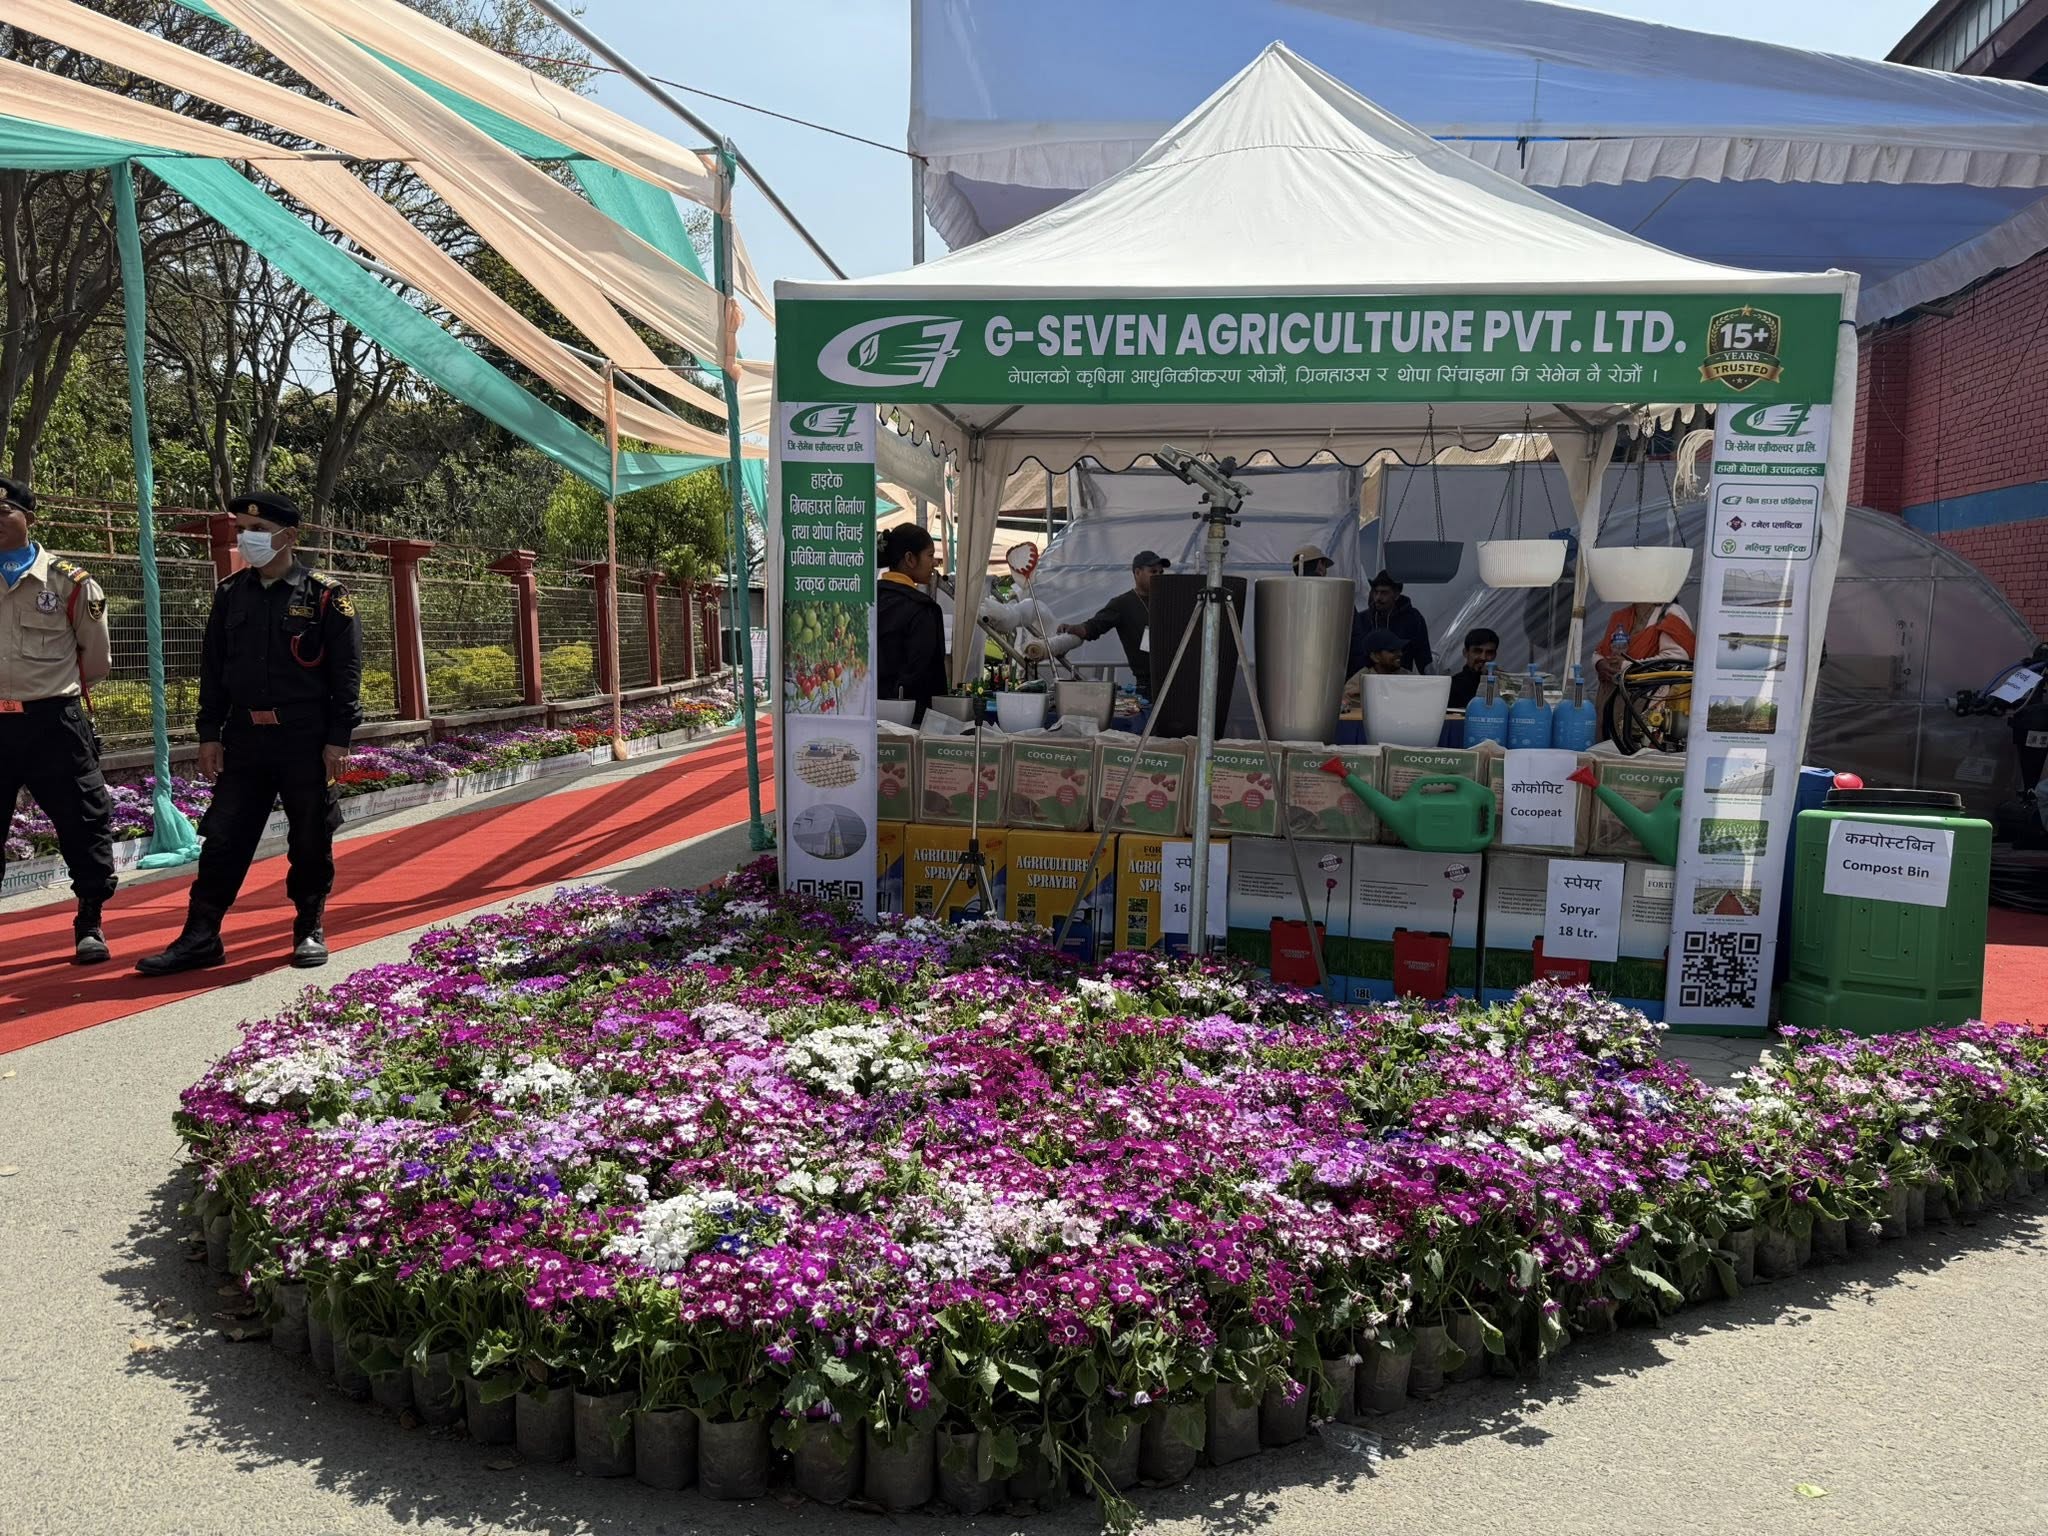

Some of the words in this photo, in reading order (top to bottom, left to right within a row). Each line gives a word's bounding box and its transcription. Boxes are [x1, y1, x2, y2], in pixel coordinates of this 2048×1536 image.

[985, 314, 1167, 356] G-SEVEN
[1175, 310, 1474, 355] AGRICULTURE
[1483, 310, 1582, 353] PVT.
[1592, 310, 1687, 354] LTD.
[1720, 323, 1769, 349] 15+
[1723, 352, 1760, 361] YEARS
[1008, 366, 1070, 384] नेपालको
[1076, 367, 1126, 388] कृषिमा
[1131, 366, 1242, 388] आधुनिकीकरण
[1295, 365, 1371, 385] ग्रिनहाउस
[1377, 367, 1389, 382] र
[1398, 363, 1431, 383] थोपा
[1437, 364, 1506, 384] सिंचाइमा
[1511, 364, 1530, 382] जि
[1537, 363, 1579, 383] सेभेन
[1587, 363, 1602, 382] नै
[1713, 363, 1768, 375] TRUSTED
[811, 468, 844, 490] हाइटेक
[790, 493, 832, 516] ग्रिनहाउस
[835, 494, 866, 516] निर्माण
[792, 524, 809, 540] तथा
[812, 521, 833, 541] थोपा
[791, 545, 826, 567] प्रविधिमा
[829, 548, 865, 567] नेपालकै
[829, 573, 861, 592] कम्पनी
[879, 749, 896, 757] EAT
[937, 748, 963, 757] COCO
[964, 750, 987, 758] PET
[1027, 751, 1053, 760] COCO
[1054, 754, 1078, 762] PEAT
[1403, 755, 1432, 764] COCO
[1434, 757, 1462, 766] PEAT
[1145, 758, 1169, 767] PEAT
[1239, 757, 1265, 766] PEAT
[1619, 773, 1650, 783] COCO
[1652, 774, 1680, 784] PEAT
[1511, 780, 1564, 795] कोकोपिट
[1510, 807, 1562, 819] Cocopeat
[1845, 832, 1936, 852] कम्पोस्टबिन
[1016, 855, 1090, 872] AGRICULTURE
[1843, 859, 1903, 876] Compost
[1907, 866, 1930, 878] Bin
[1027, 873, 1077, 890] SPRAYER
[1563, 874, 1603, 891] स्पेयर
[1174, 903, 1187, 913] 16
[1560, 902, 1600, 916] Spryar
[1558, 926, 1573, 937] 18
[1577, 927, 1598, 939] Ltr.
